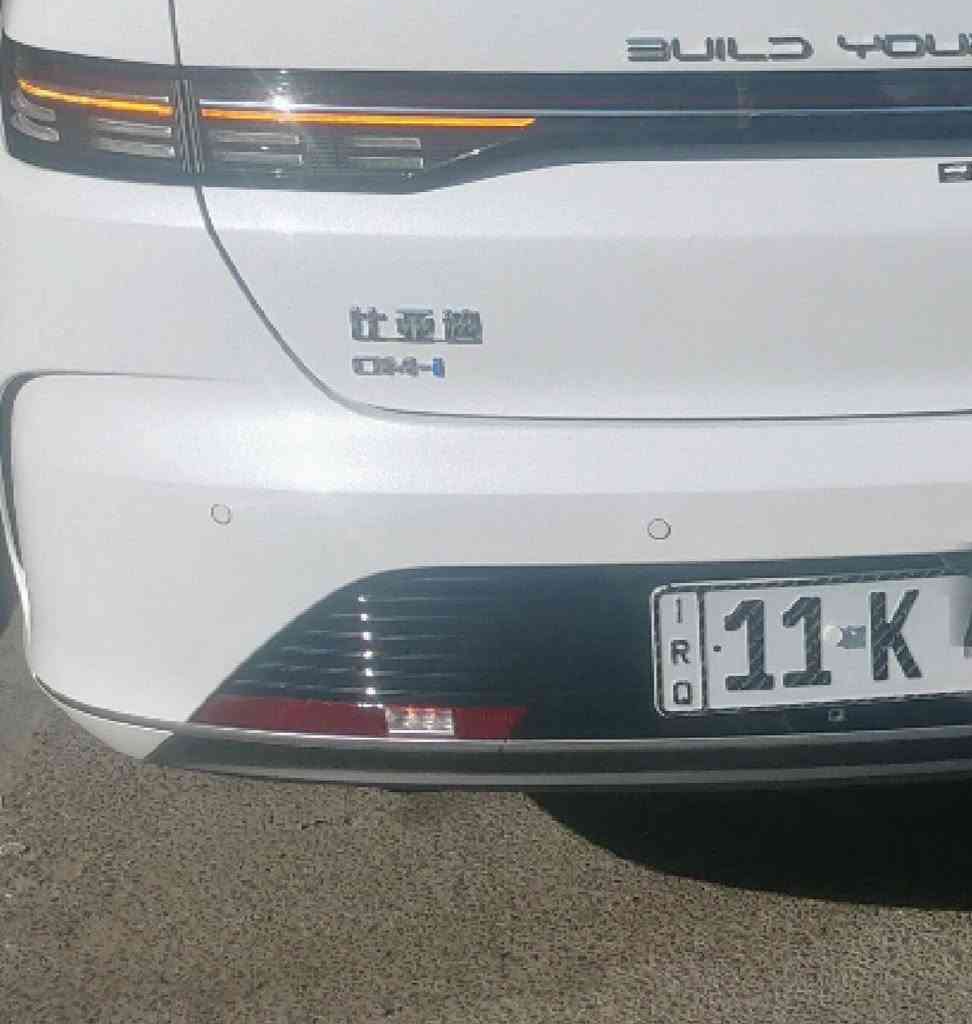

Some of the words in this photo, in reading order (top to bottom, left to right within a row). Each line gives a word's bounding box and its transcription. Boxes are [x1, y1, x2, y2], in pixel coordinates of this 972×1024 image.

[625, 36, 814, 62] BUILD
[350, 307, 483, 344] 比亚迪
[724, 597, 832, 691] 11
[870, 588, 923, 681] K
